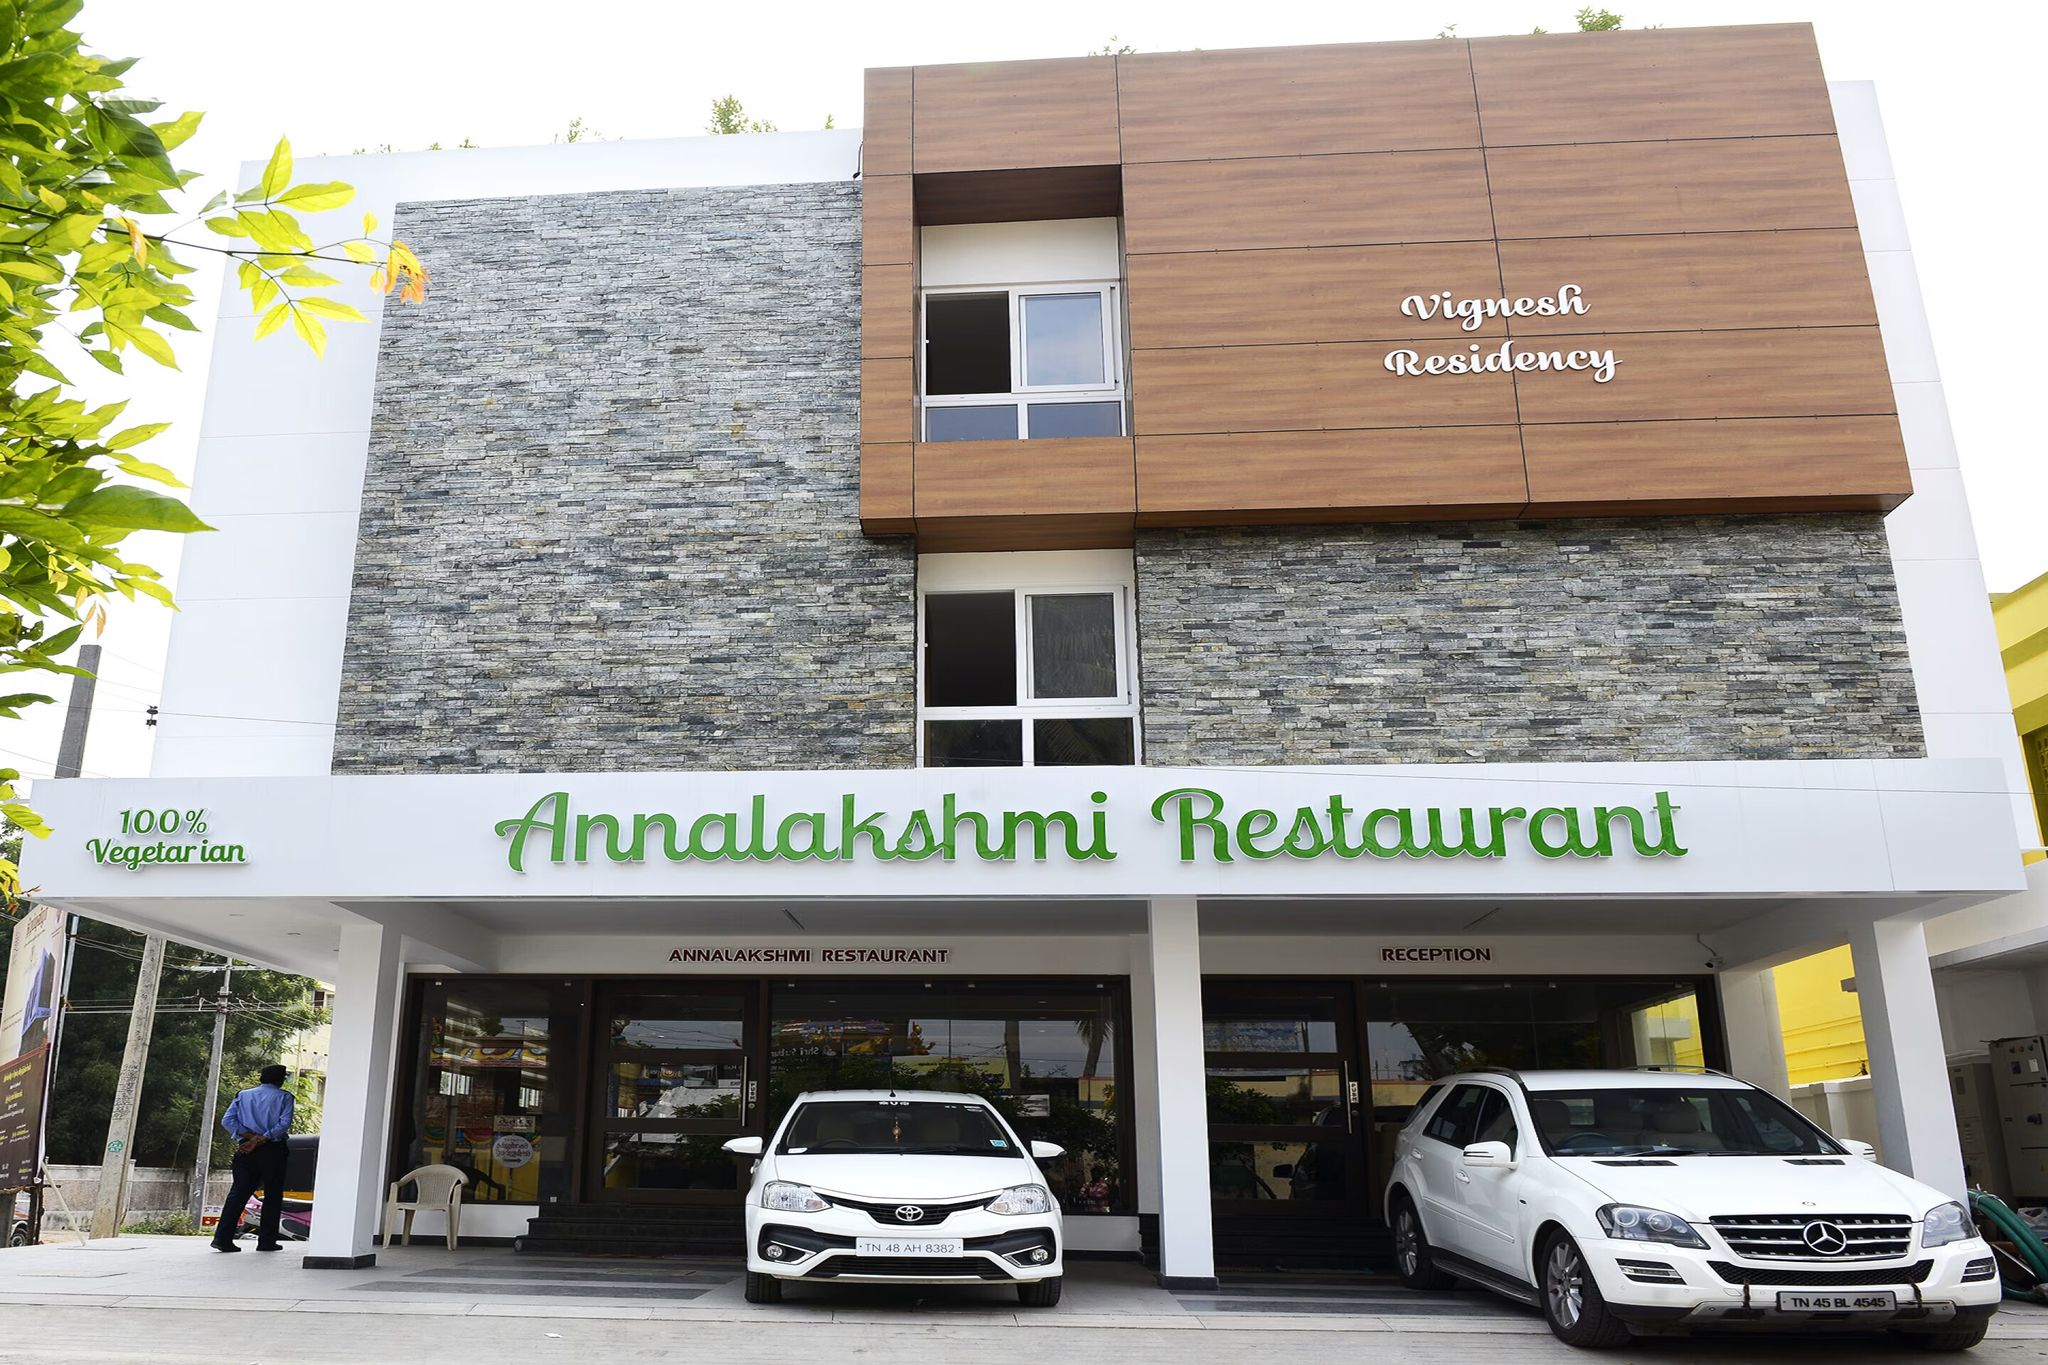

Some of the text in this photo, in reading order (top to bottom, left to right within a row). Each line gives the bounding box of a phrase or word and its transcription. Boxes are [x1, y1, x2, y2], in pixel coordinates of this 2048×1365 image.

[1400, 284, 1591, 331] Vignesh
[1384, 340, 1623, 383] Residency
[119, 808, 209, 835] 100%
[495, 788, 1689, 873] Annalakshmi Restaurant
[86, 838, 246, 871] Vegetarian
[668, 949, 949, 963] ANNALAKSHMI RESTAURANT
[1381, 948, 1492, 961] RECEPTION
[865, 1243, 955, 1253] TN 48 AH 8382
[1791, 1297, 1886, 1308] TN 45 BL 4545
